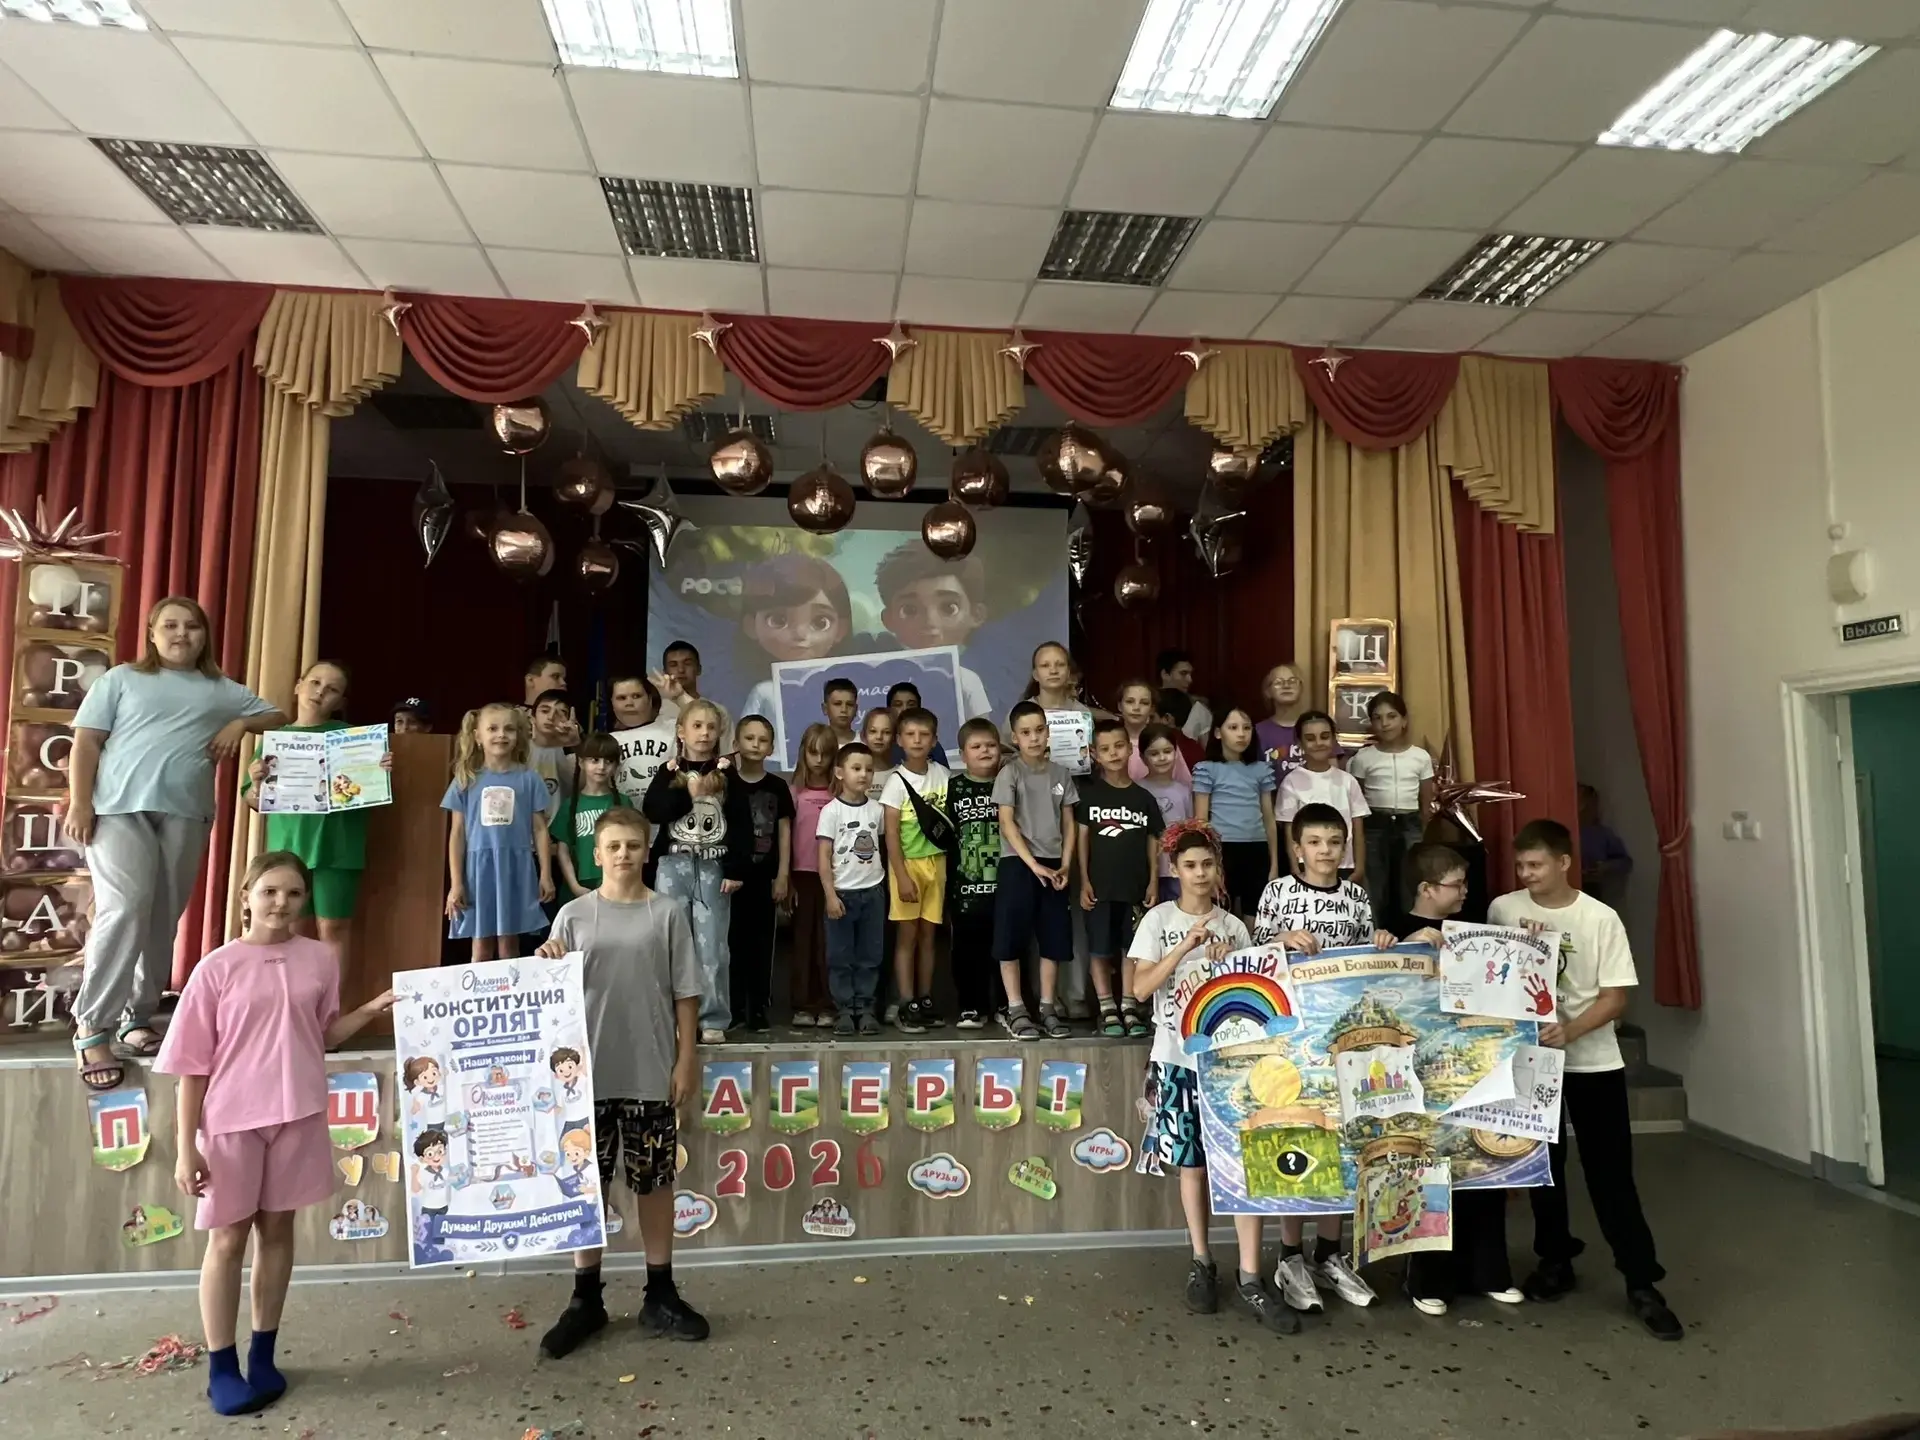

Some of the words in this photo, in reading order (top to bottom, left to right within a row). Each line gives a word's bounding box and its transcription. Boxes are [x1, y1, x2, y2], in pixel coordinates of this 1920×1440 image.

[1846, 619, 1899, 639] ВЫХОД
[1047, 718, 1081, 726] РАМОТА
[275, 743, 326, 752] ГРАМОТА
[331, 732, 383, 746] ГРАМОТА
[954, 797, 972, 812] NO
[1089, 805, 1148, 827] Reebok
[1463, 941, 1535, 969] ДРУЖБА
[1291, 963, 1340, 980] Страна
[1343, 959, 1399, 972] Больших
[1401, 957, 1425, 971] Дел
[1174, 953, 1278, 1010] РАДУЖНЫЙ
[423, 988, 565, 1020] КОНСТИТУЦИЯ
[453, 1008, 543, 1038] ОРЛЯТ
[1214, 1024, 1251, 1042] ГОРОД
[463, 1057, 492, 1069] Наши
[494, 1053, 531, 1066] законы
[504, 1106, 530, 1115] ОРЛЯТ
[1355, 1099, 1377, 1112] ГОРОД
[1378, 1092, 1415, 1106] ПОЗИТИВА
[1088, 1145, 1115, 1156] ИГРЫ
[716, 1137, 884, 1198] 2026
[920, 1170, 959, 1183] ДРУЗЬЯ
[440, 1220, 481, 1234] Думаем!
[483, 1216, 527, 1234] Дружим!
[529, 1205, 583, 1228] Действуем!
[674, 1208, 703, 1219] ТДЫХ
